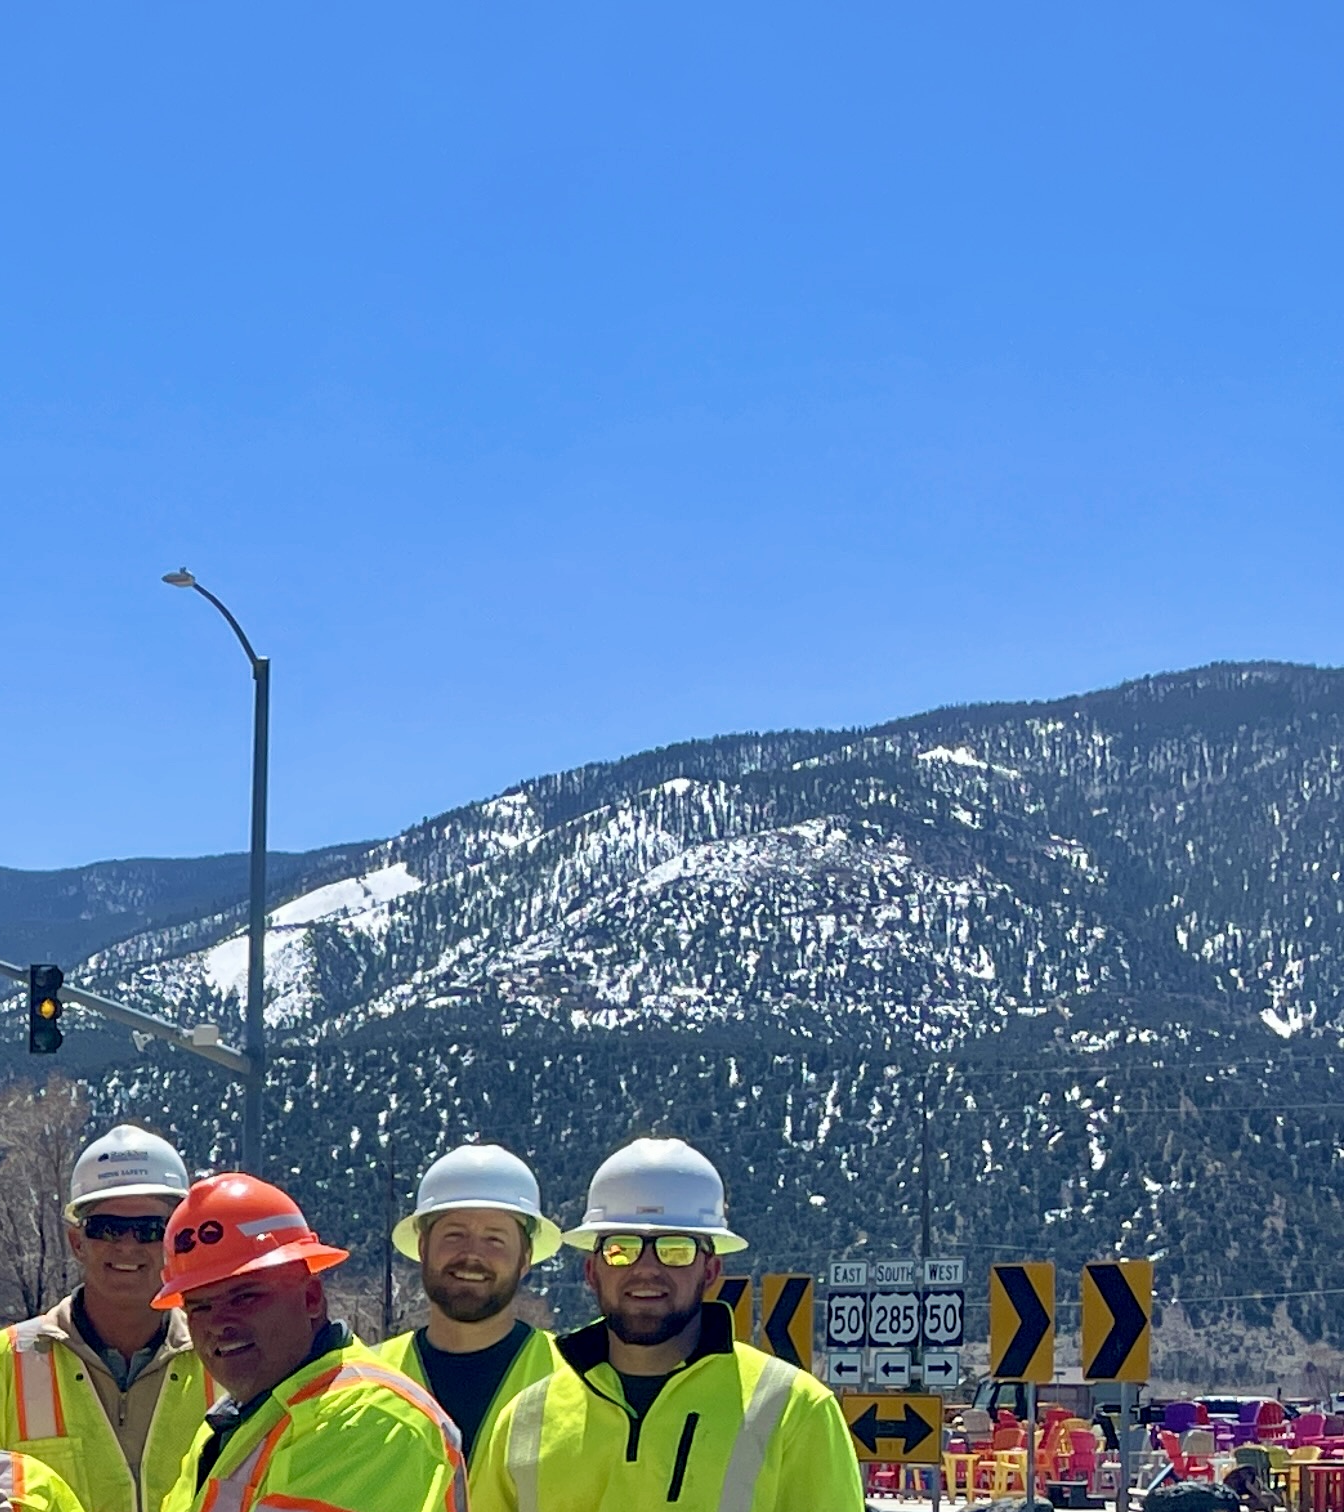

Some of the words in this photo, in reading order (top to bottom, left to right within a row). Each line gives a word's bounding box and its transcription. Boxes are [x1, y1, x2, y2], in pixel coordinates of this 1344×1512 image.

[834, 1266, 862, 1283] EAST
[877, 1265, 913, 1282] SOUTH
[928, 1264, 960, 1281] WEST
[834, 1306, 860, 1334] 50
[875, 1306, 914, 1334] 285
[929, 1304, 957, 1333] 50
